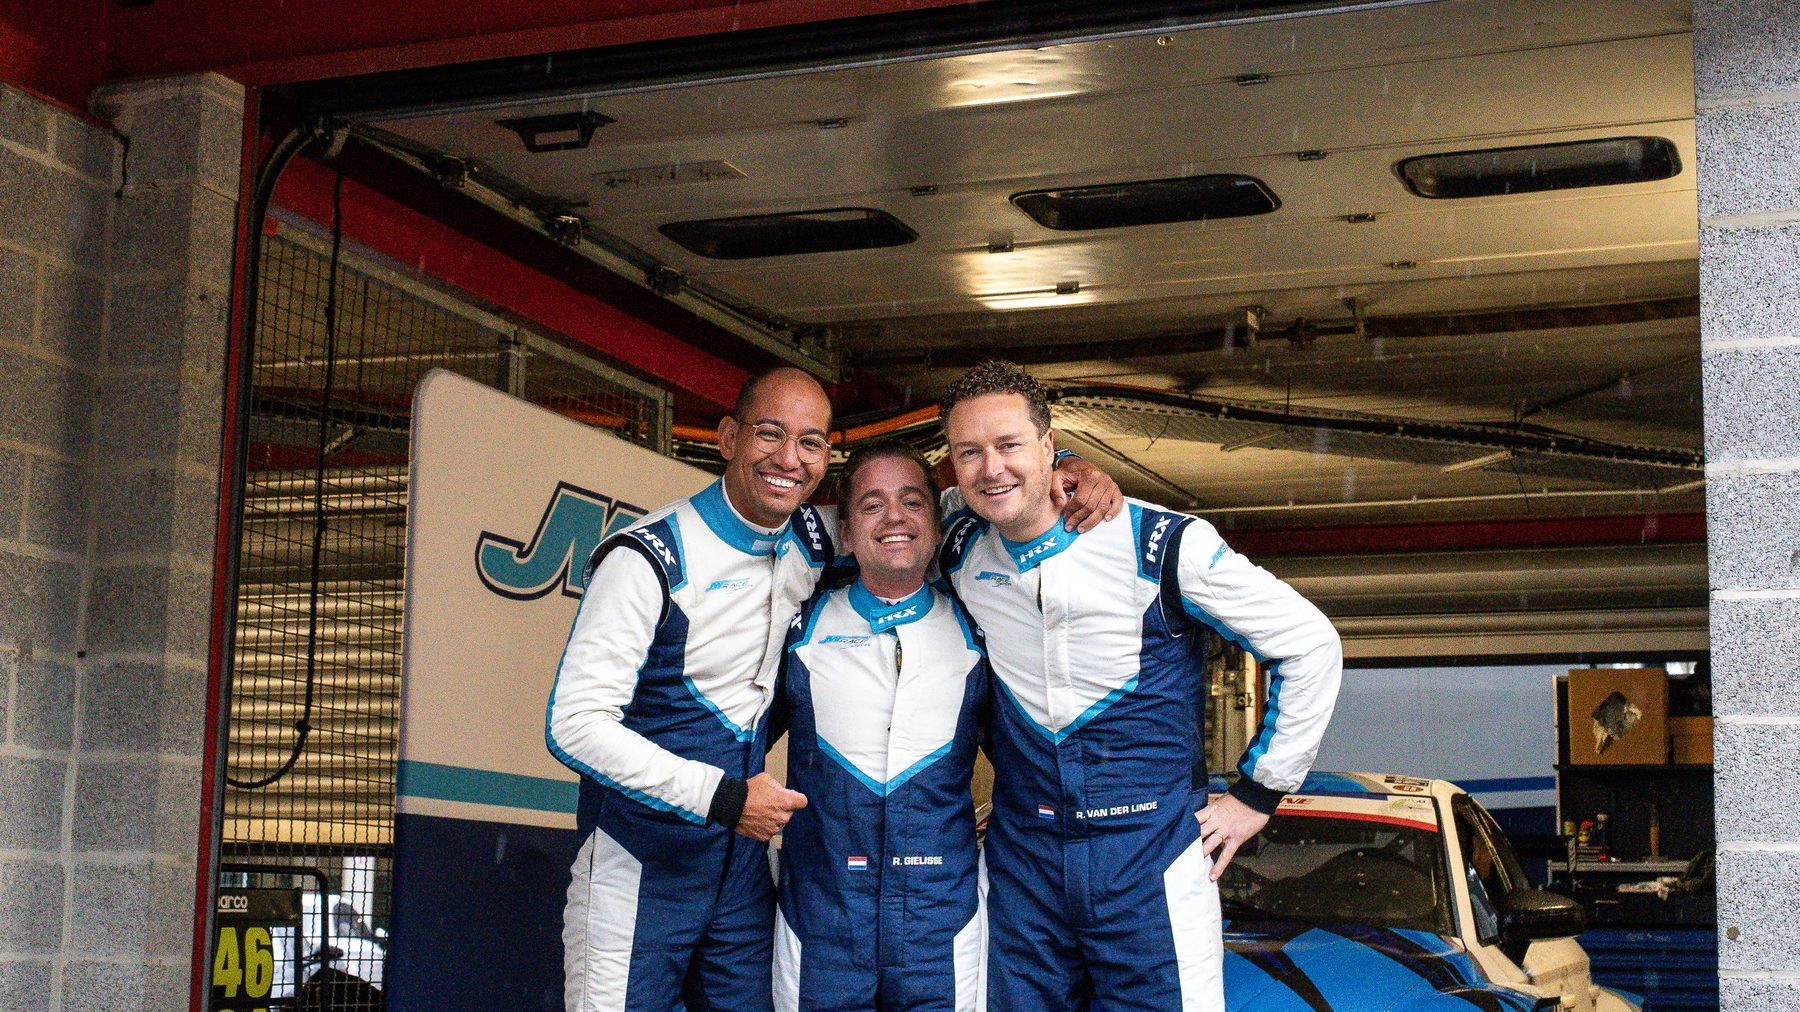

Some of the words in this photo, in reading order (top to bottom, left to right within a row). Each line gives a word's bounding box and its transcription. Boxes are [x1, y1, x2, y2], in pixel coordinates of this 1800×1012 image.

[635, 527, 677, 567] HRX
[1020, 536, 1057, 563] HRX
[1146, 515, 1172, 563] HRX
[878, 605, 917, 625] HRX
[1076, 811, 1086, 819] R.
[1086, 808, 1108, 818] VAN
[1110, 805, 1129, 816] DER
[1131, 801, 1158, 812] LINDE
[892, 856, 903, 866] R.
[904, 856, 943, 866] GIELISSE
[217, 895, 248, 909] arco
[213, 926, 274, 999] 46
